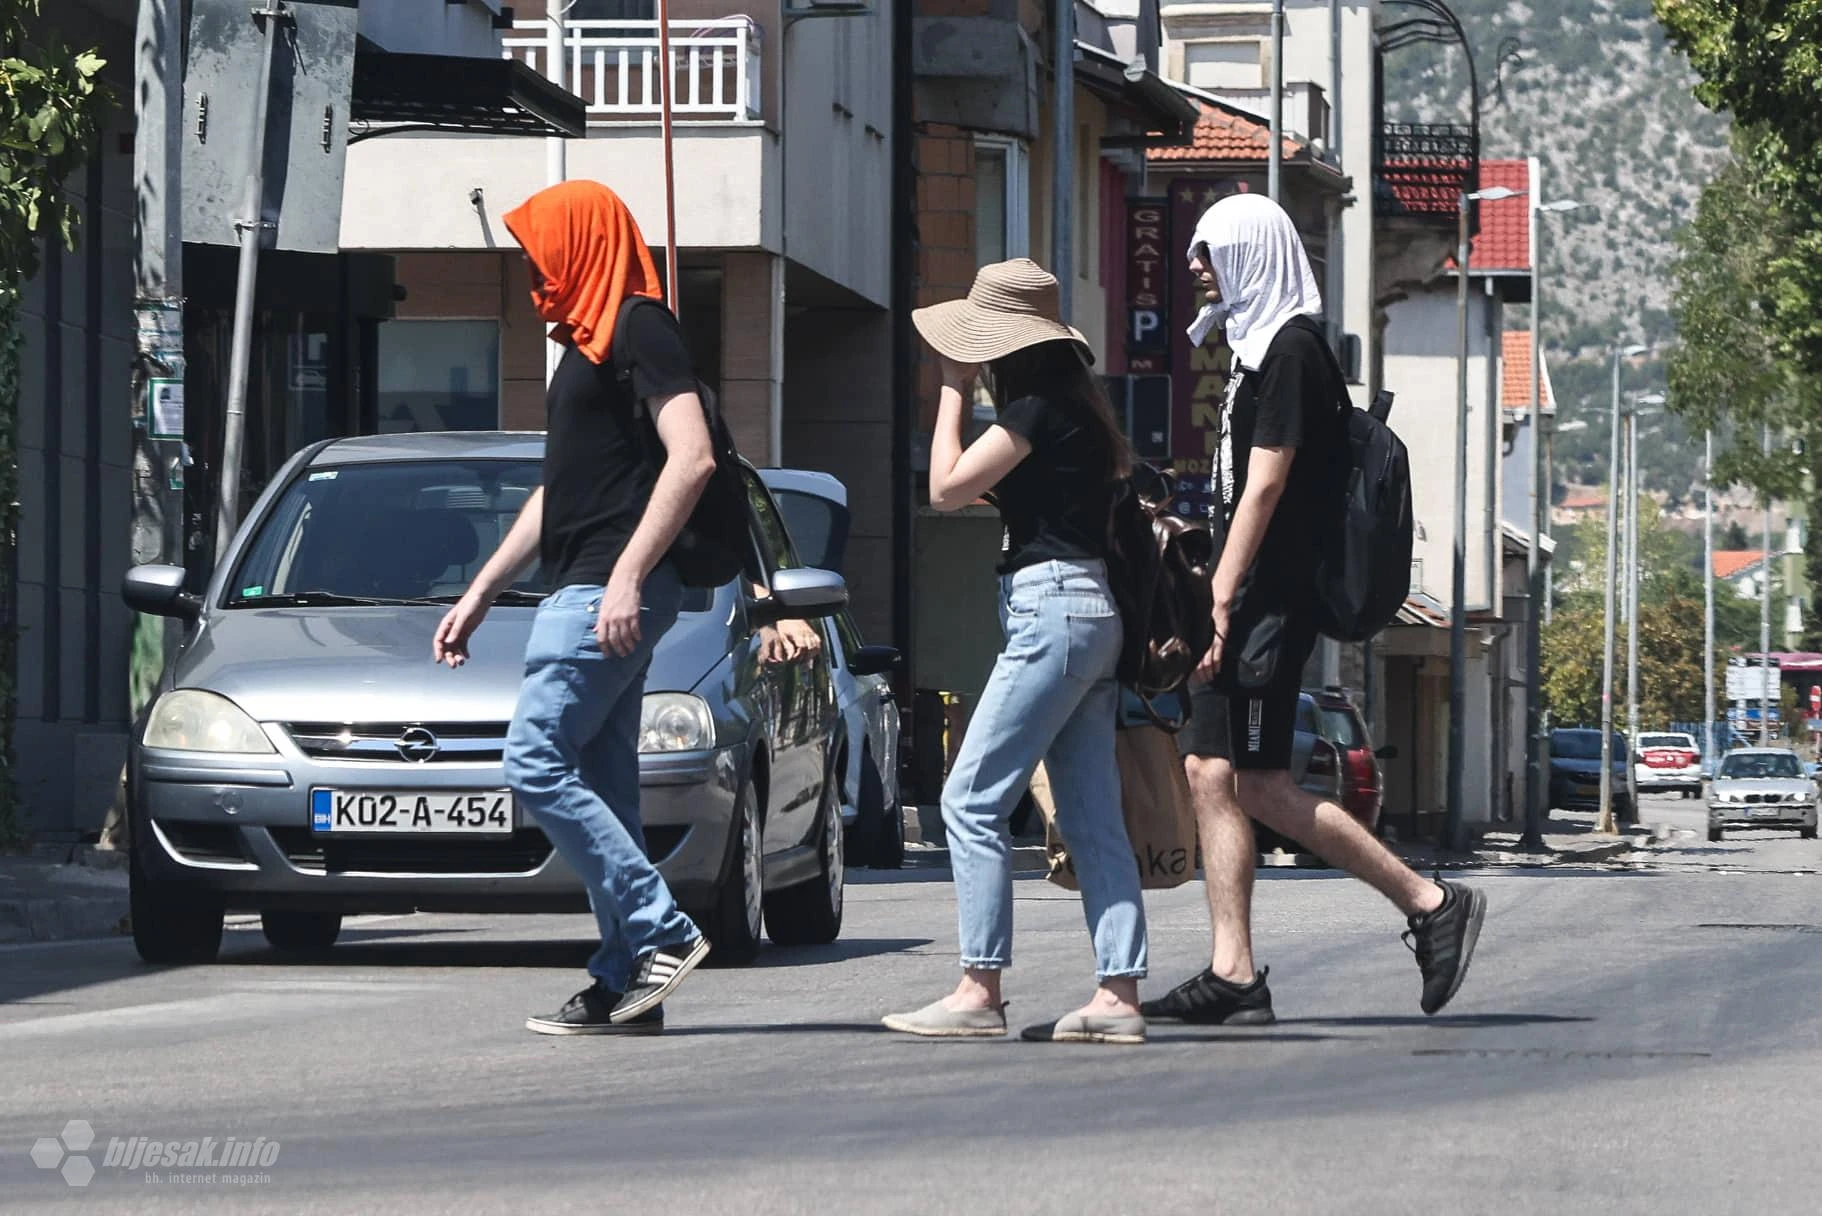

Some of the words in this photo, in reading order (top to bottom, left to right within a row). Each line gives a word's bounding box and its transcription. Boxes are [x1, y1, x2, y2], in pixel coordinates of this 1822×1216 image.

[1132, 208, 1161, 306] GRATIS
[1133, 310, 1159, 343] P
[314, 813, 331, 824] BIH
[336, 794, 507, 828] K02-A-454
